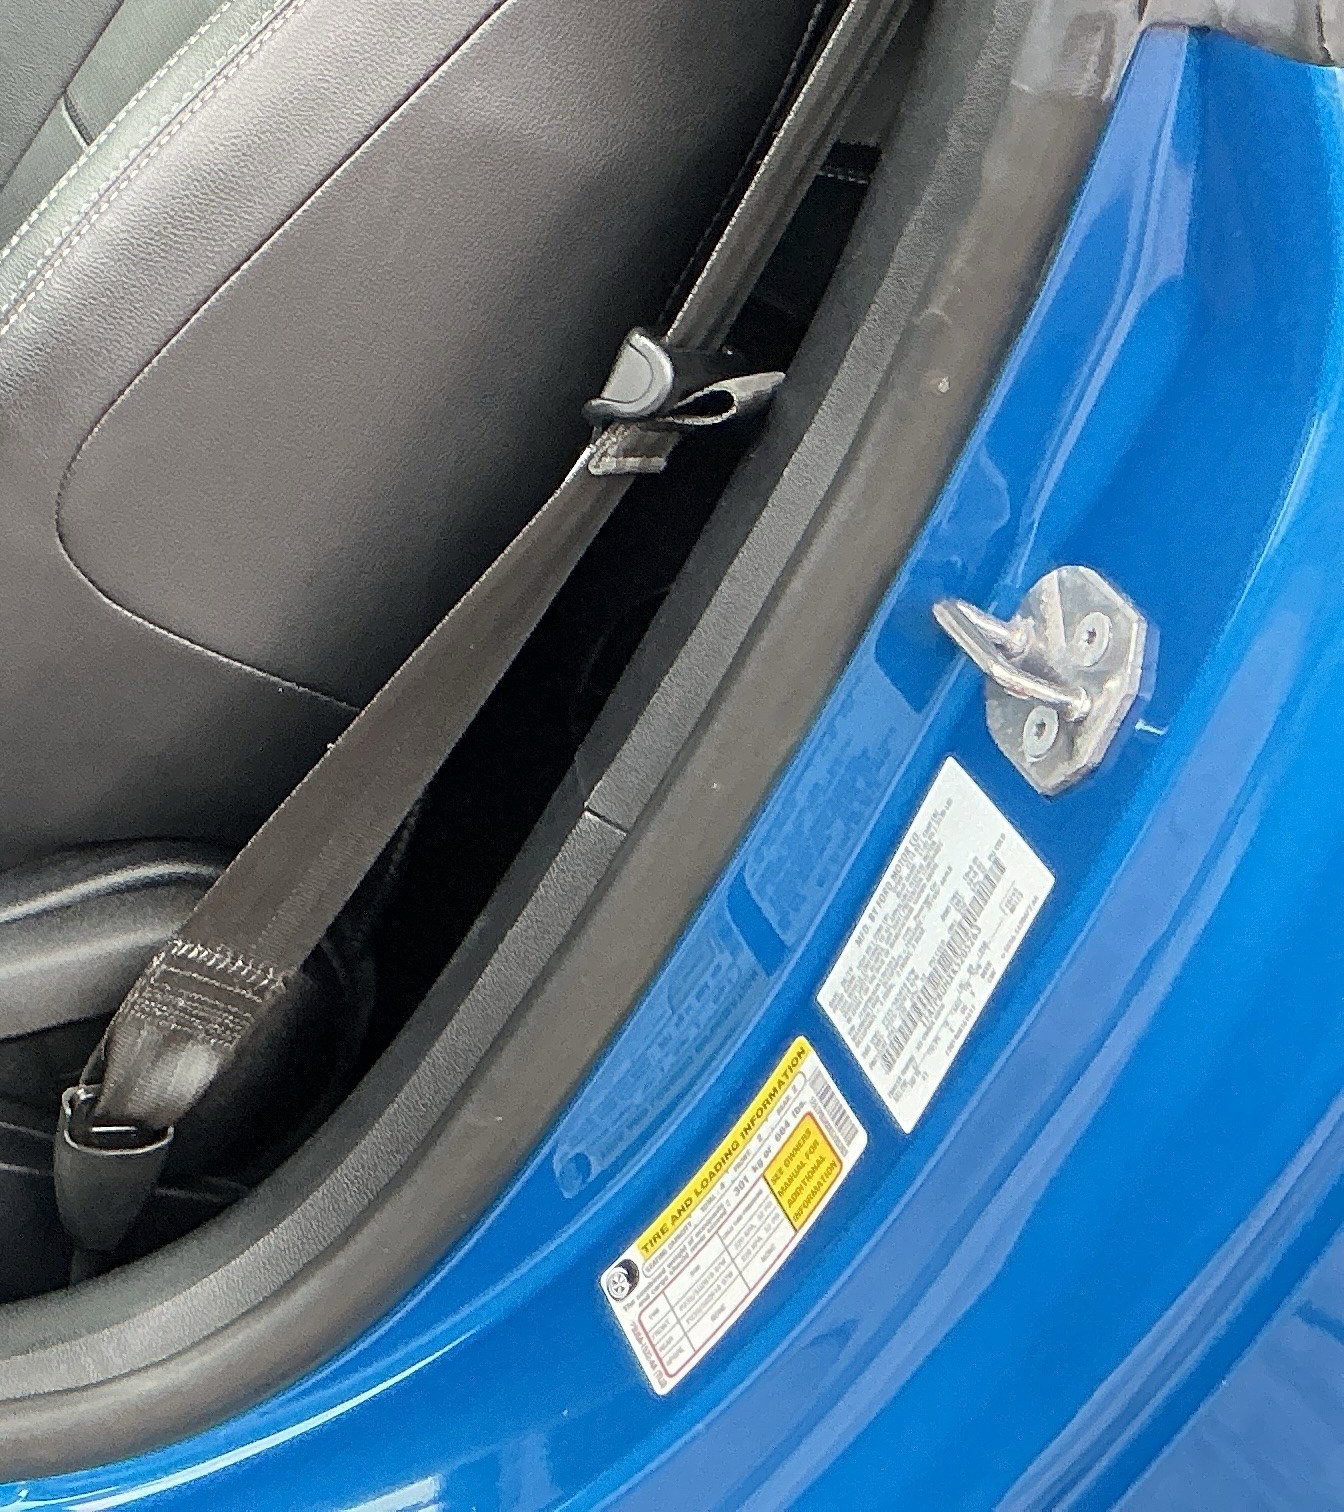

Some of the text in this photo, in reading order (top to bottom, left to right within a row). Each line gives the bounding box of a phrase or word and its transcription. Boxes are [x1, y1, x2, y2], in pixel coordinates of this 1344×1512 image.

[640, 1044, 806, 1256] TIRE AND LOADING INFORMATION
[776, 1137, 820, 1198] MANUAL FOR
[782, 1126, 812, 1169] OWNERS
[785, 1151, 827, 1209] ADDITIONAL
[791, 1158, 838, 1223] INFORMATION
